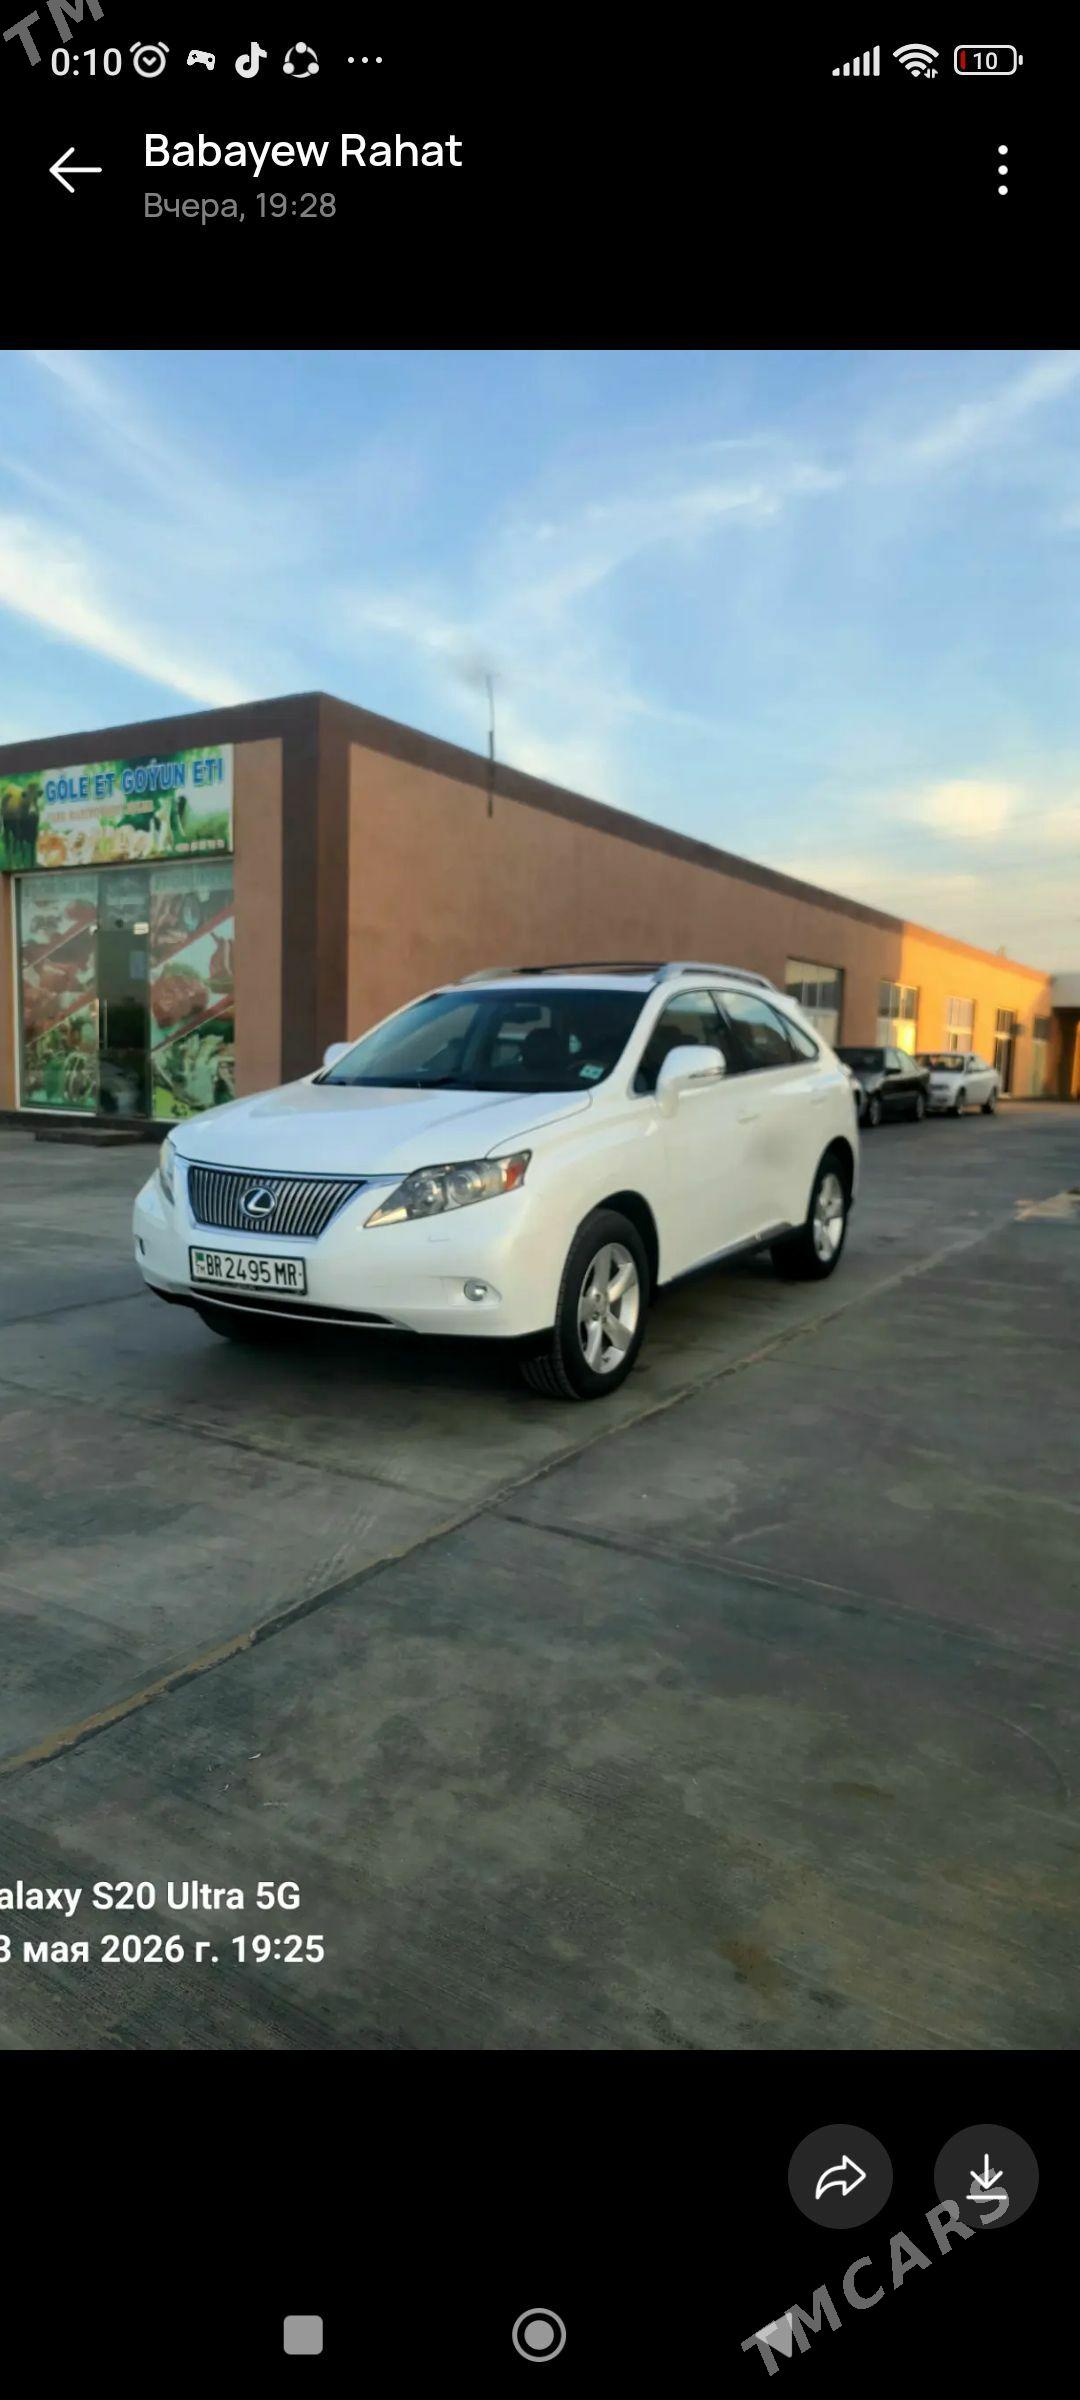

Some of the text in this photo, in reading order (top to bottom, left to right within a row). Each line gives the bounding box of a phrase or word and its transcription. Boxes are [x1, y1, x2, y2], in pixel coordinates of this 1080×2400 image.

[51, 48, 122, 76] 0:10
[973, 52, 998, 70] 10
[145, 133, 463, 178] Babayew Rahat
[144, 192, 337, 225] Вчера, 19:28
[94, 771, 116, 800] ET
[191, 757, 224, 788] ETI
[225, 1256, 272, 1283] 2495
